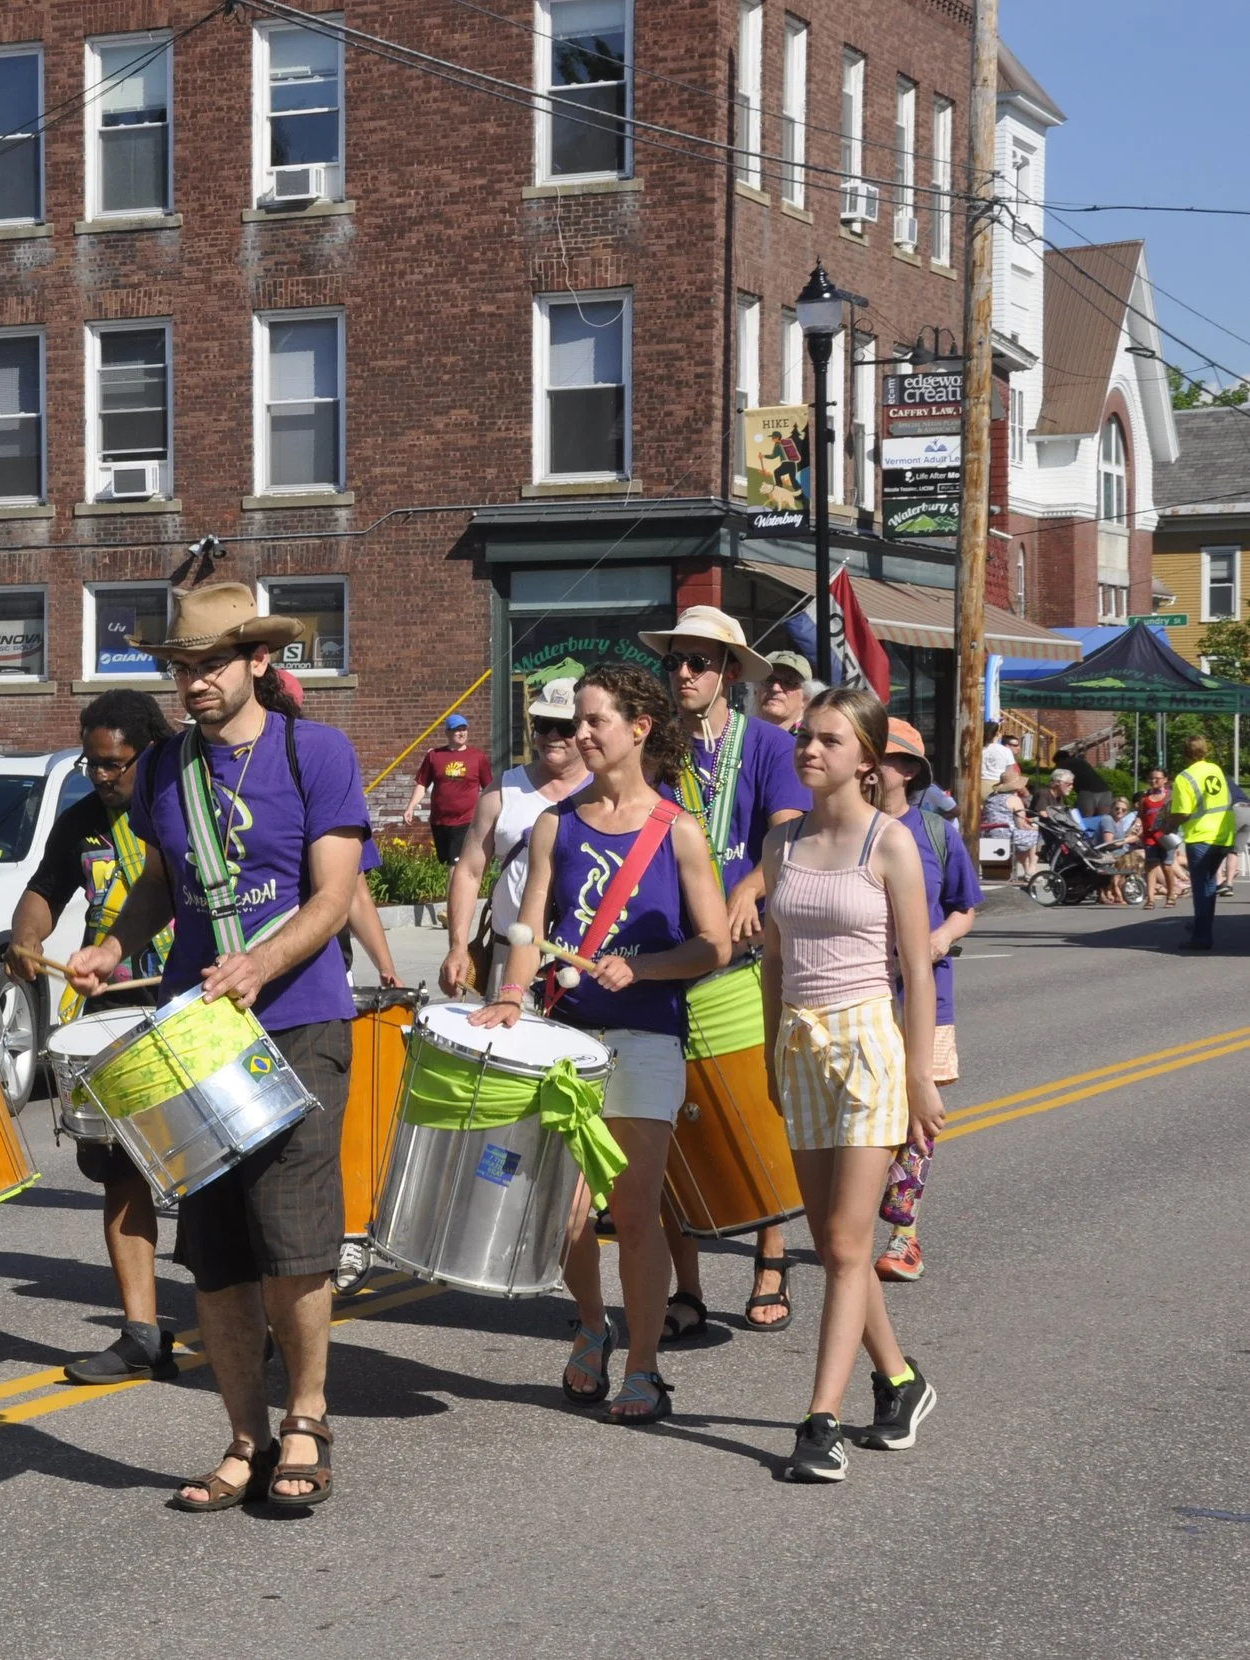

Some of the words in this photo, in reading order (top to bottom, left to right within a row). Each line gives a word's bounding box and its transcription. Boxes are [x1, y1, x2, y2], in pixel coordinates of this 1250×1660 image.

[904, 374, 962, 391] edgewo
[904, 386, 962, 403] creati
[889, 408, 930, 418] CAFFRY
[762, 419, 790, 429] HIKE
[885, 457, 921, 465] Vermont
[923, 455, 947, 464] Adult
[949, 455, 960, 463] Le
[947, 471, 961, 479] Mo
[888, 502, 949, 527] Waterbury
[754, 512, 803, 528] Waterbury
[1134, 617, 1170, 626] Fundry
[108, 622, 126, 632] Liv
[111, 652, 154, 663] GIANT
[513, 636, 610, 674] Waterbury
